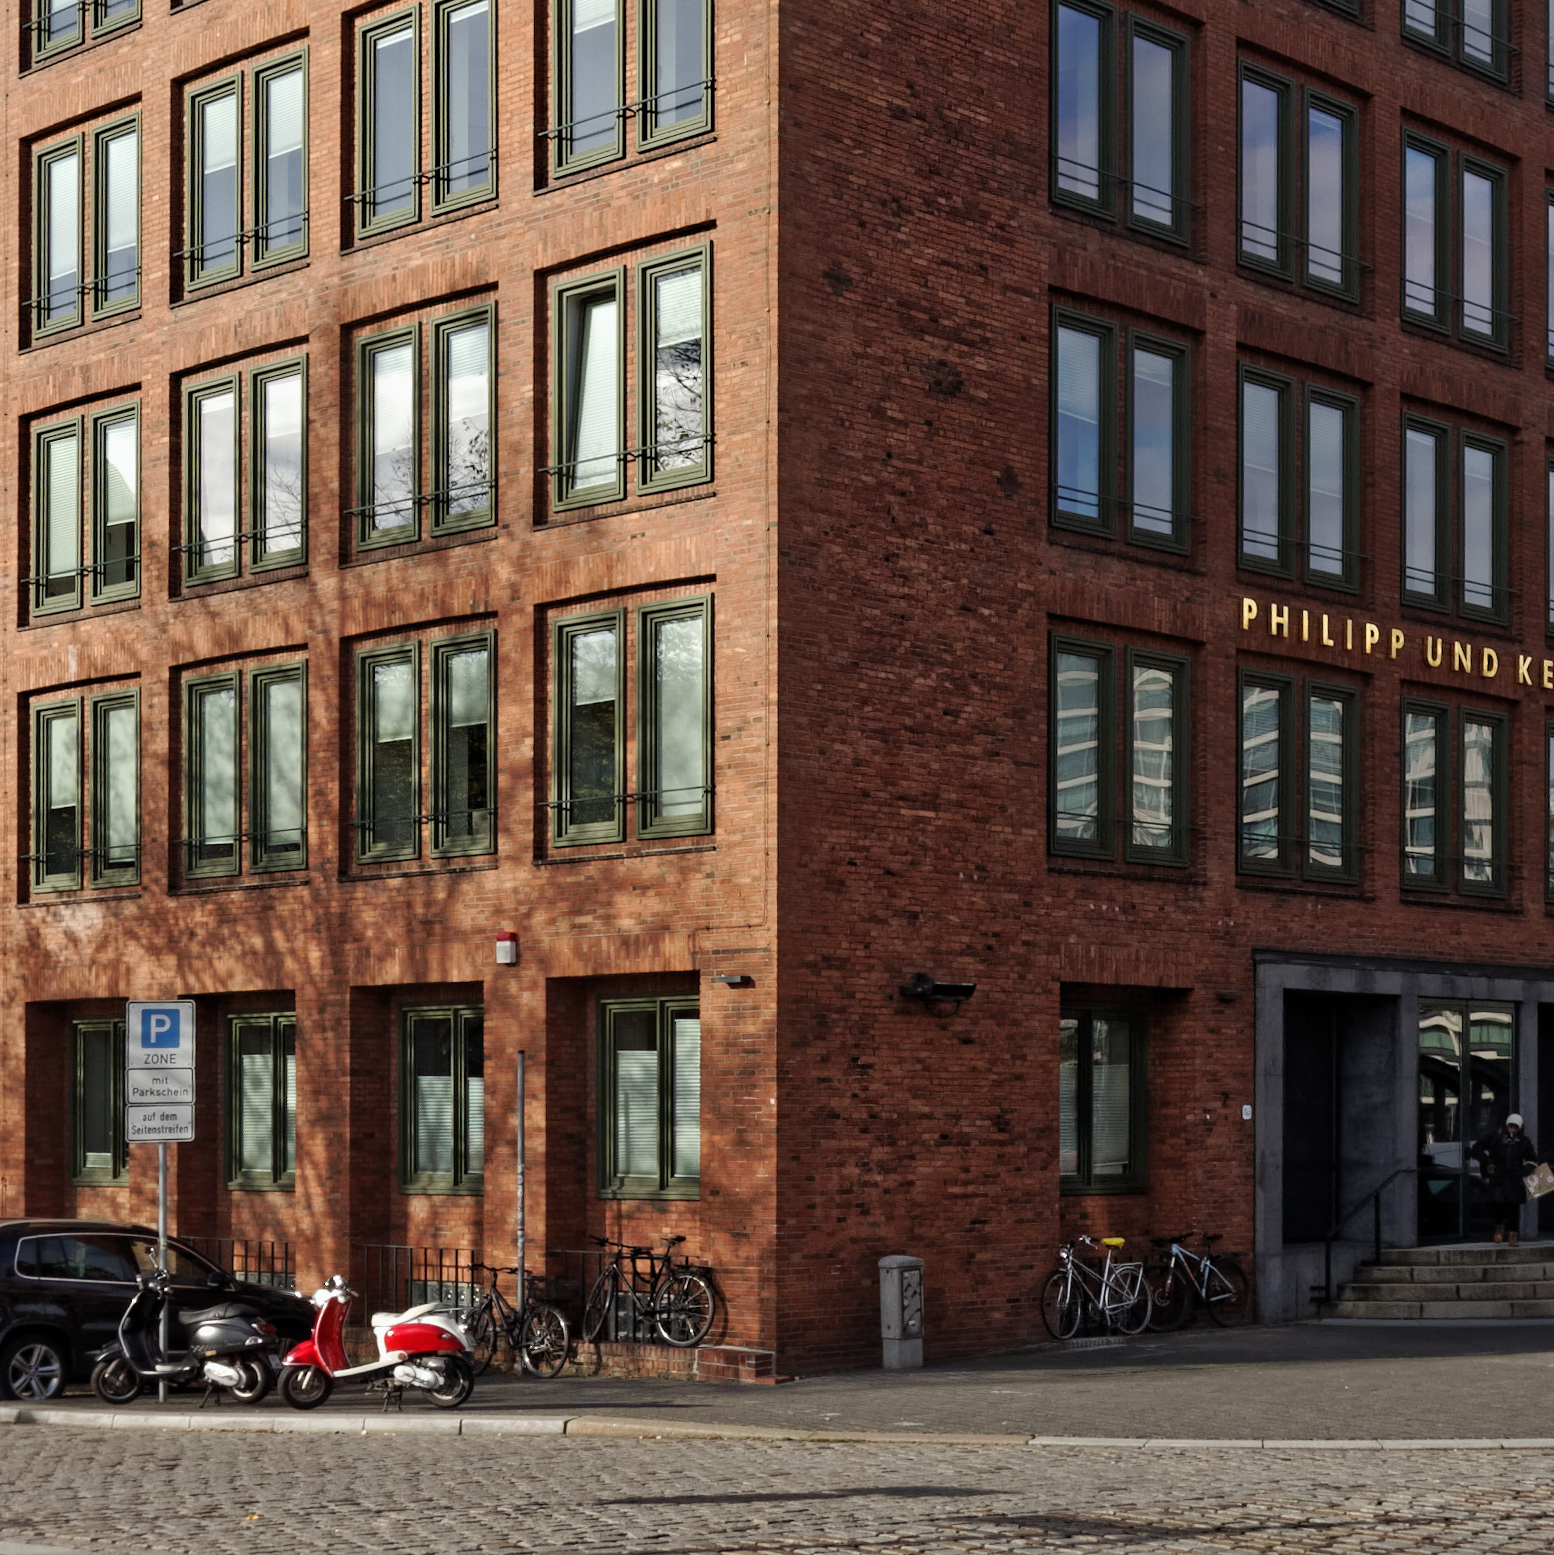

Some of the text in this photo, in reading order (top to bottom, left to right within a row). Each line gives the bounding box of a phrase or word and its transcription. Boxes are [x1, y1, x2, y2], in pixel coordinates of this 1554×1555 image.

[1242, 597, 1405, 659] PHILIPP
[1425, 636, 1499, 678] UND
[150, 1014, 171, 1044] P
[144, 1053, 177, 1064] ZONE
[152, 1076, 168, 1085] mit
[132, 1087, 188, 1097] Parkschein
[142, 1111, 177, 1122] auf dem
[131, 1124, 188, 1135] Seitenstreifen
